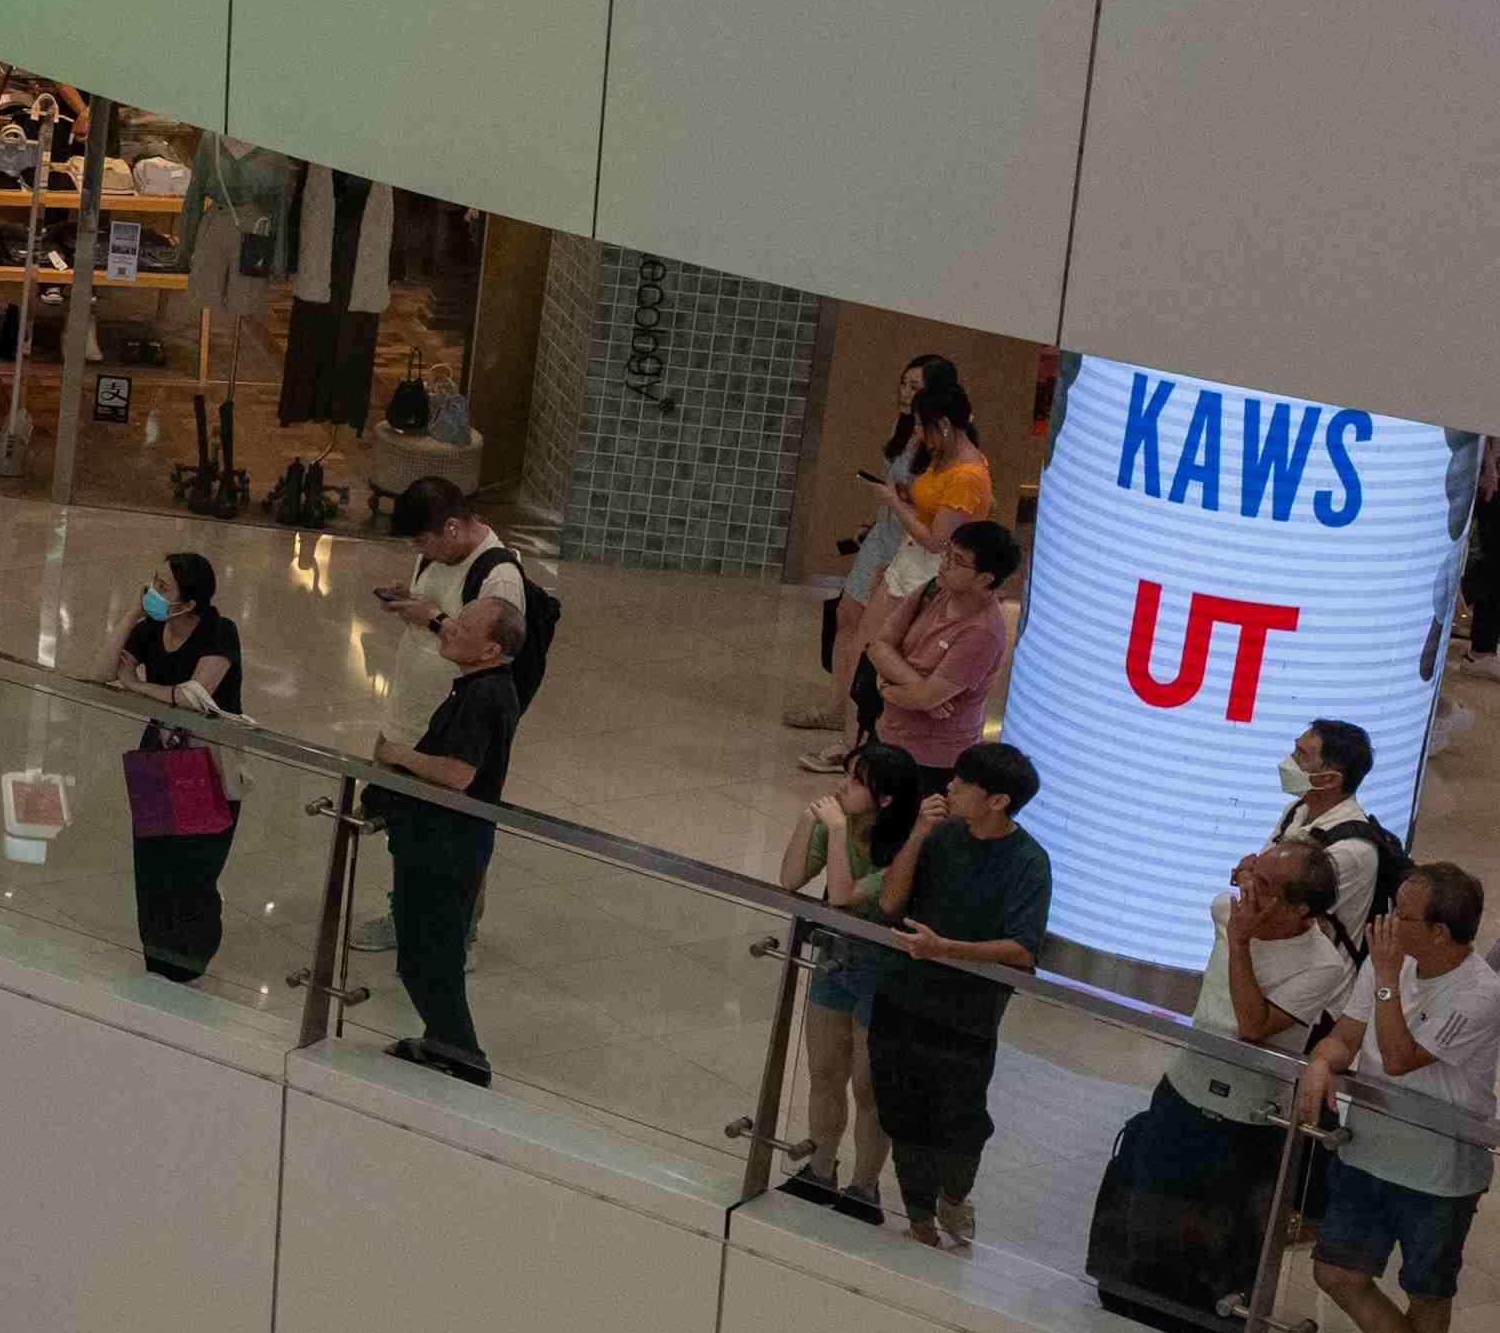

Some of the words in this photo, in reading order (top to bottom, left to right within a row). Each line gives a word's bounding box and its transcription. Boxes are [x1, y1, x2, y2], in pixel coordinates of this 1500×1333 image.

[626, 255, 669, 403] ecology
[1116, 371, 1374, 529] KAWS
[1125, 579, 1301, 724] UT
